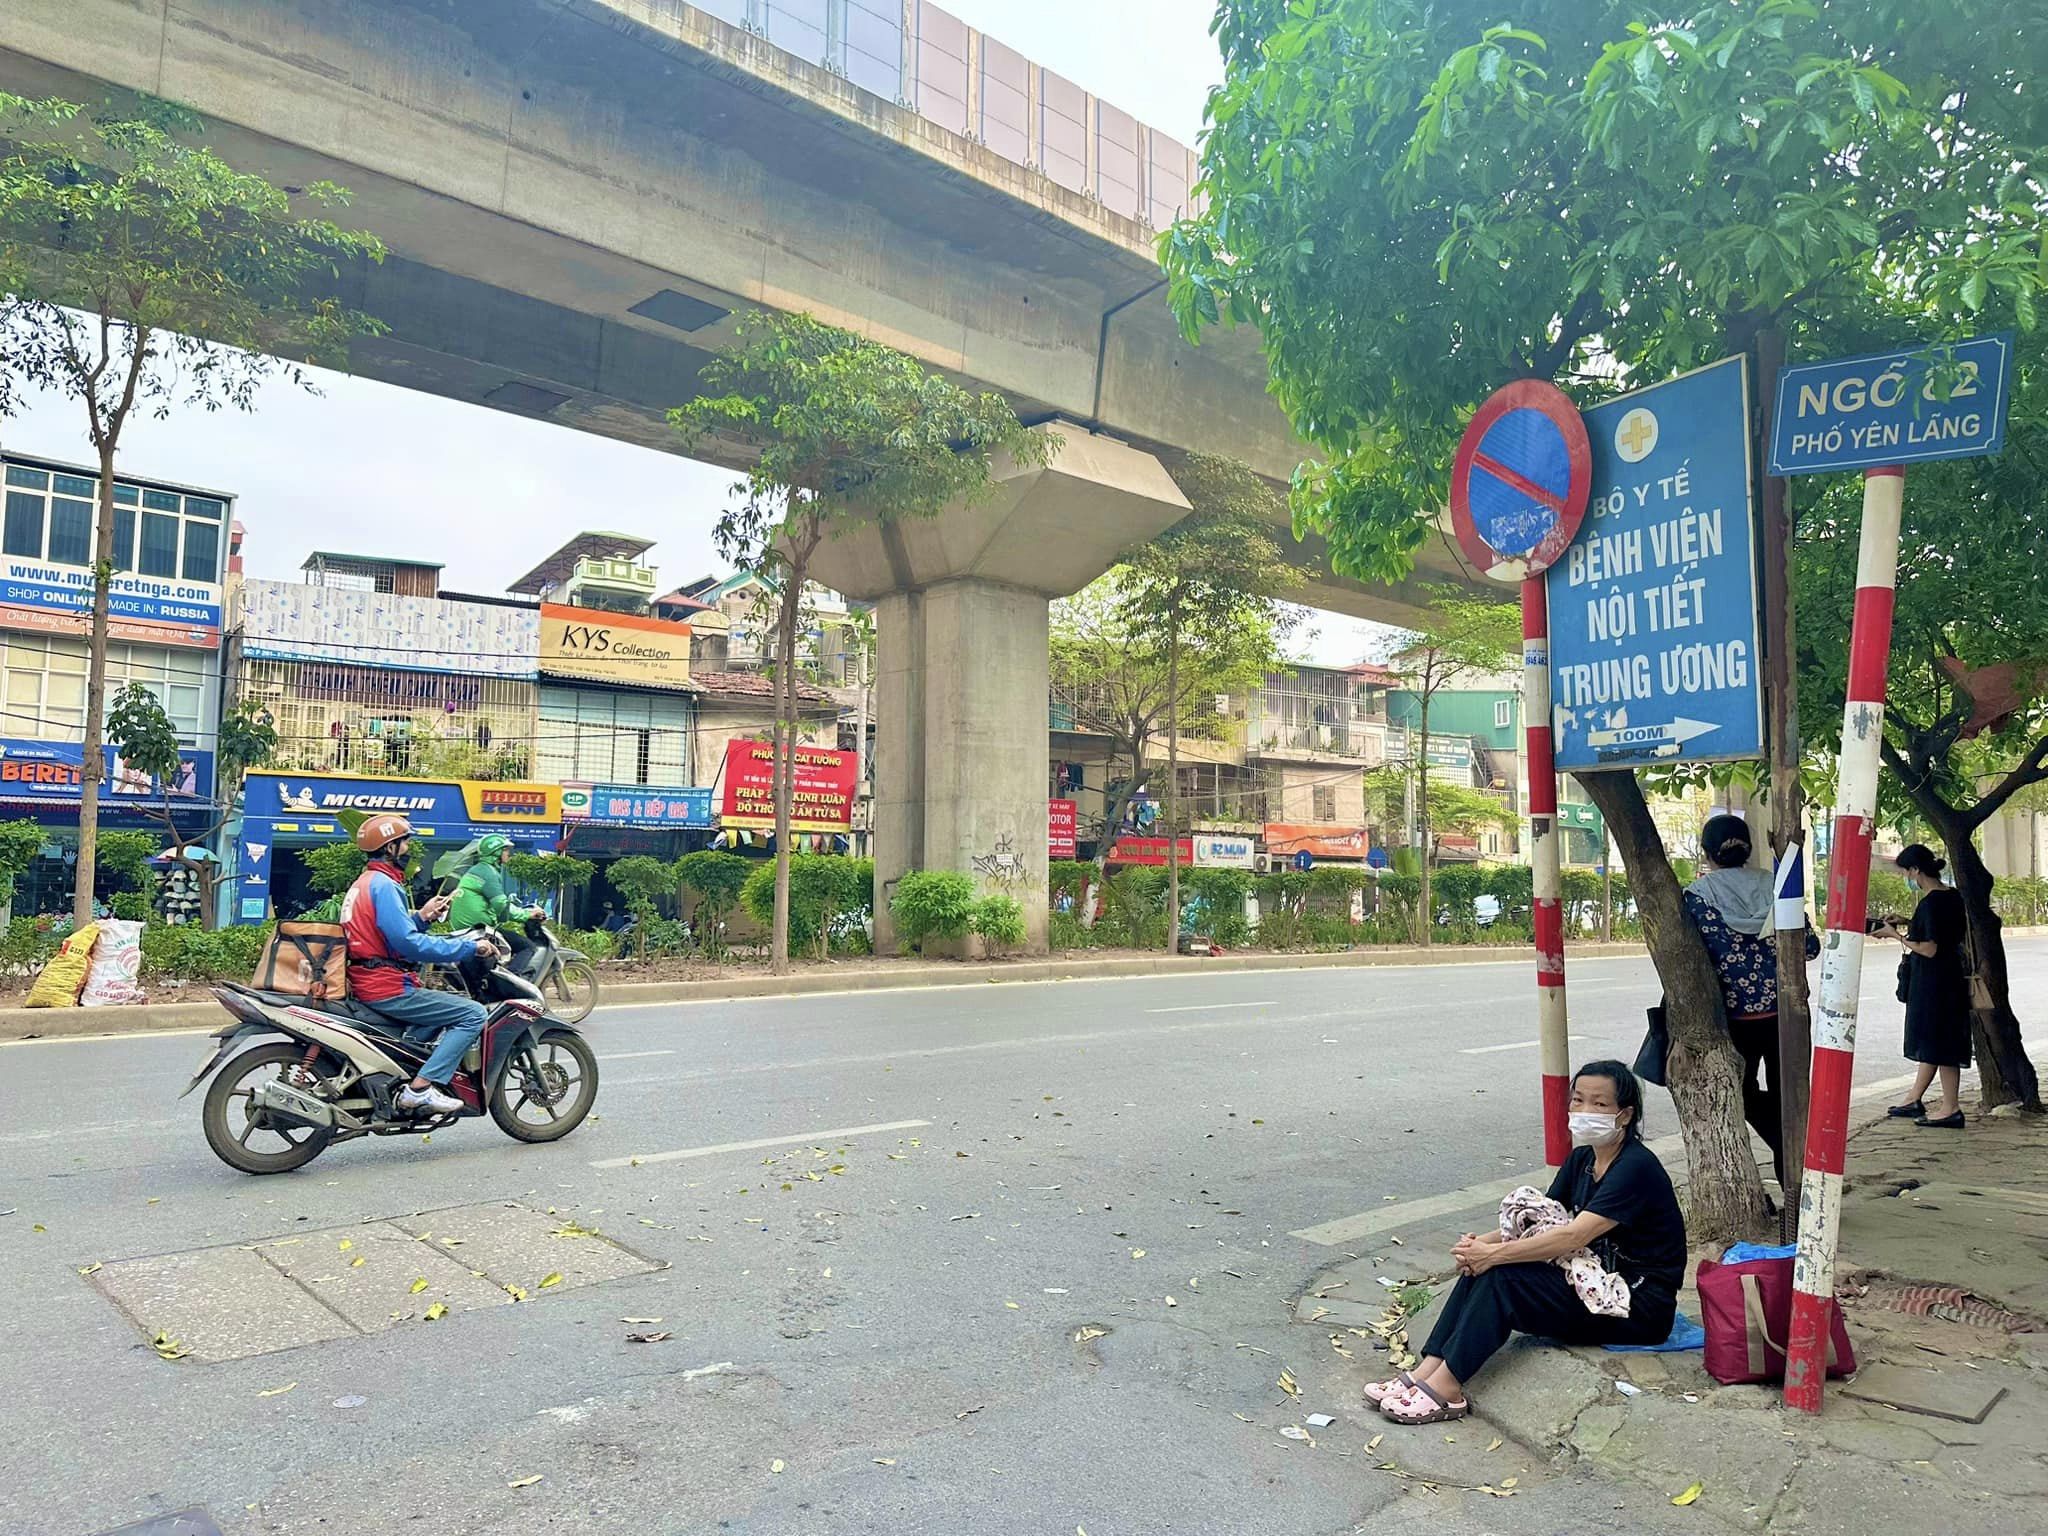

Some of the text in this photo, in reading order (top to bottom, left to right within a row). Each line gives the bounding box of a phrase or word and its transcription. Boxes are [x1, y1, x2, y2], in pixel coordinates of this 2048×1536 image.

[1797, 360, 1907, 418] NGÕ
[1791, 412, 1981, 455] PHỐ YÊN LÃNG
[1593, 458, 1690, 519] BỘ Y TẾ
[1568, 506, 1723, 590] BỆNH VIỆN
[8, 587, 40, 599] SHOP
[43, 592, 95, 606] ONLINE
[108, 599, 139, 612] MADE
[160, 606, 209, 620] RUSSIA
[1587, 565, 1706, 646] NỘI TIẾT
[562, 625, 670, 659] KYS Collection
[1558, 639, 1747, 708] TRUNG ƯƠNG
[1613, 726, 1664, 742] 100M
[322, 794, 435, 809] MICHELIN
[567, 794, 583, 802] HP
[633, 799, 642, 817] &
[829, 810, 842, 819] SA
[1049, 814, 1071, 825] OTOR
